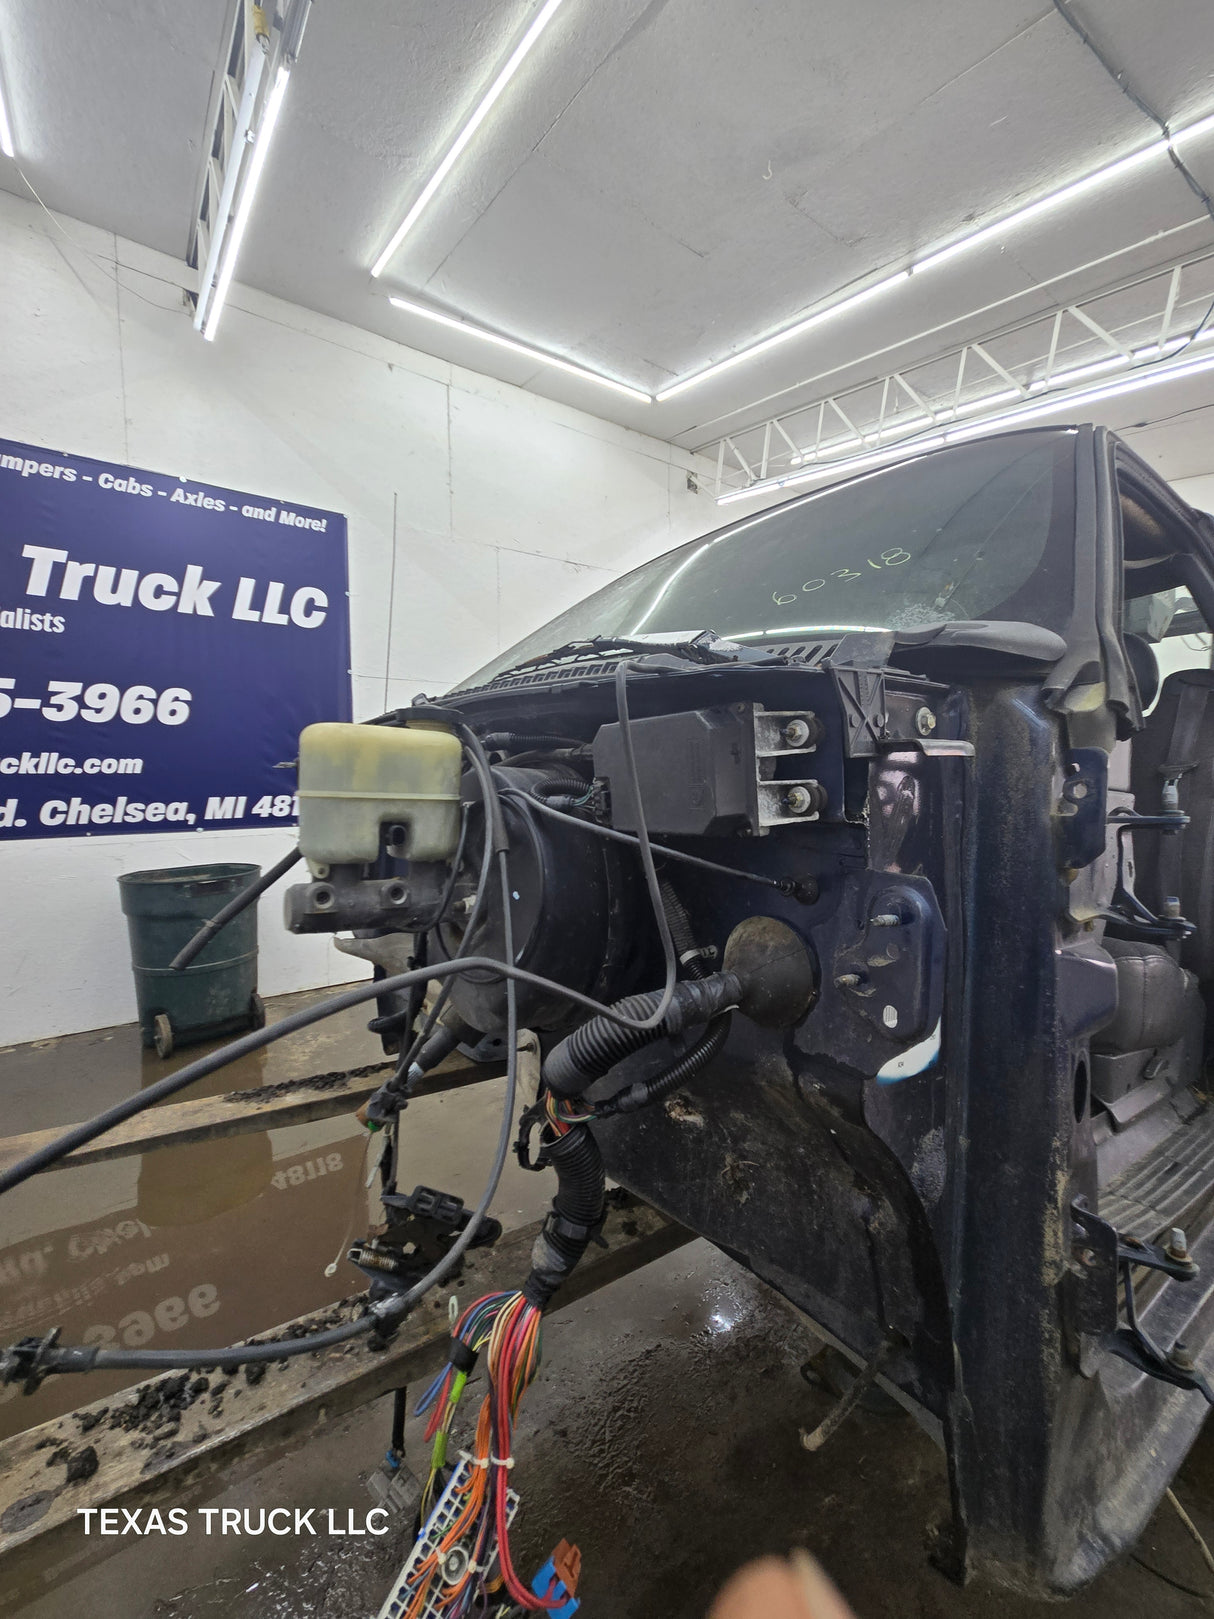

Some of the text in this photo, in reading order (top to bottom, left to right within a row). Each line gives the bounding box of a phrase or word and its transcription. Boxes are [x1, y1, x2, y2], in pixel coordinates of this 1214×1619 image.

[0, 454, 77, 481] mpers
[99, 473, 153, 496] Cabs
[170, 488, 226, 511] Axles
[241, 504, 276, 522] and
[279, 511, 327, 532] More!
[22, 545, 328, 628] Truck LLC
[771, 547, 911, 606] 60318
[1, 608, 65, 632] alists
[0, 752, 143, 774] ckllc.com
[39, 797, 198, 825] Chelsea,
[205, 797, 246, 819] MI
